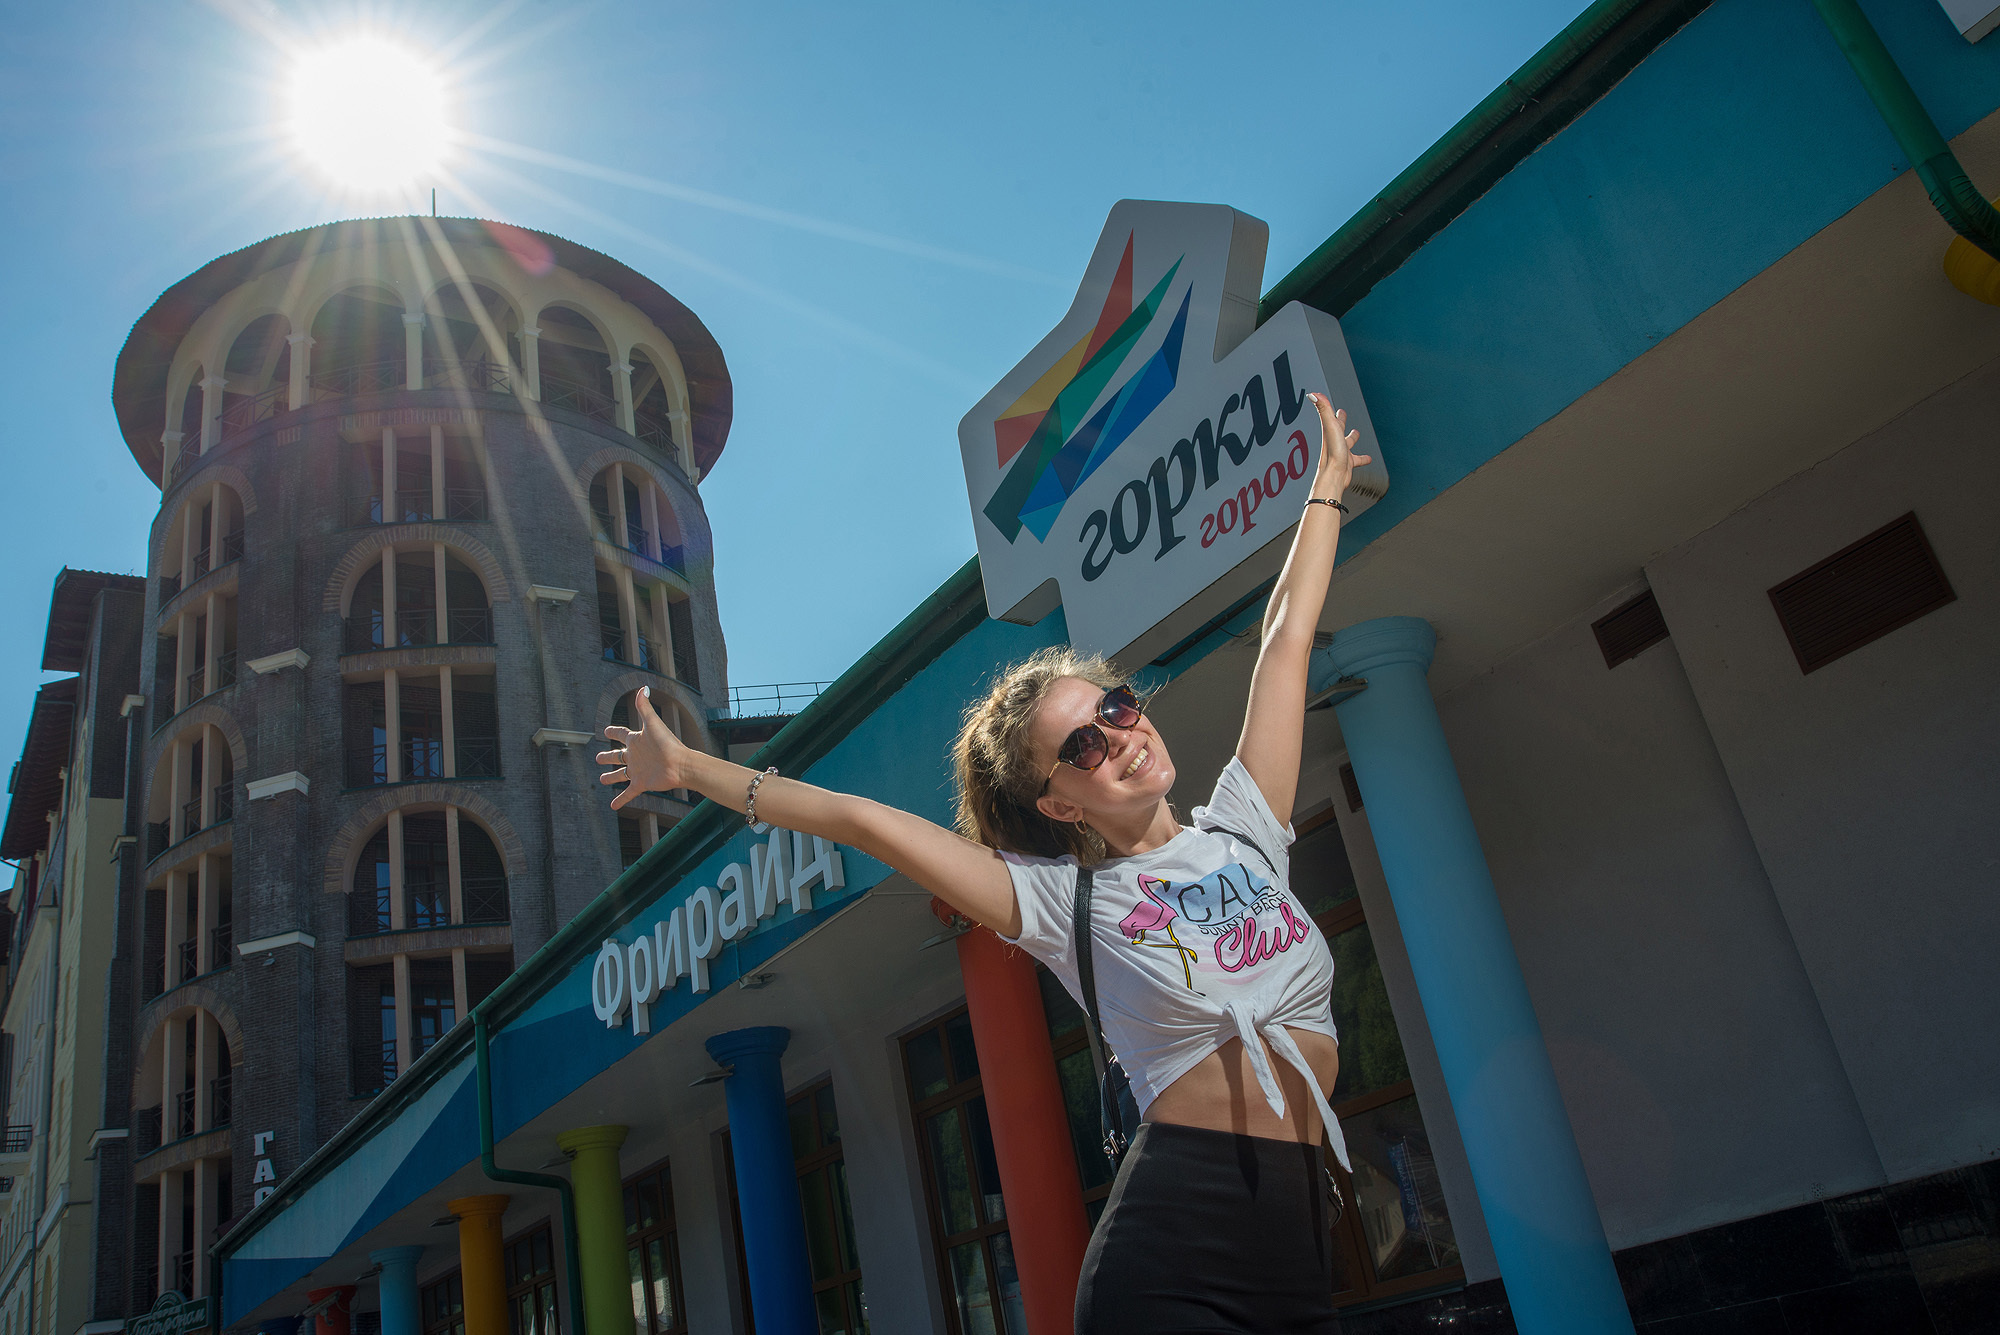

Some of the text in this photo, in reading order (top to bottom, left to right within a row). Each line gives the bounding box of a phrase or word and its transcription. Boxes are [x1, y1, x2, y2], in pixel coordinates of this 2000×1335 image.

[1079, 350, 1306, 582] горки
[1200, 430, 1309, 549] город
[592, 822, 846, 1036] Фрирайд
[1214, 902, 1309, 973] Club
